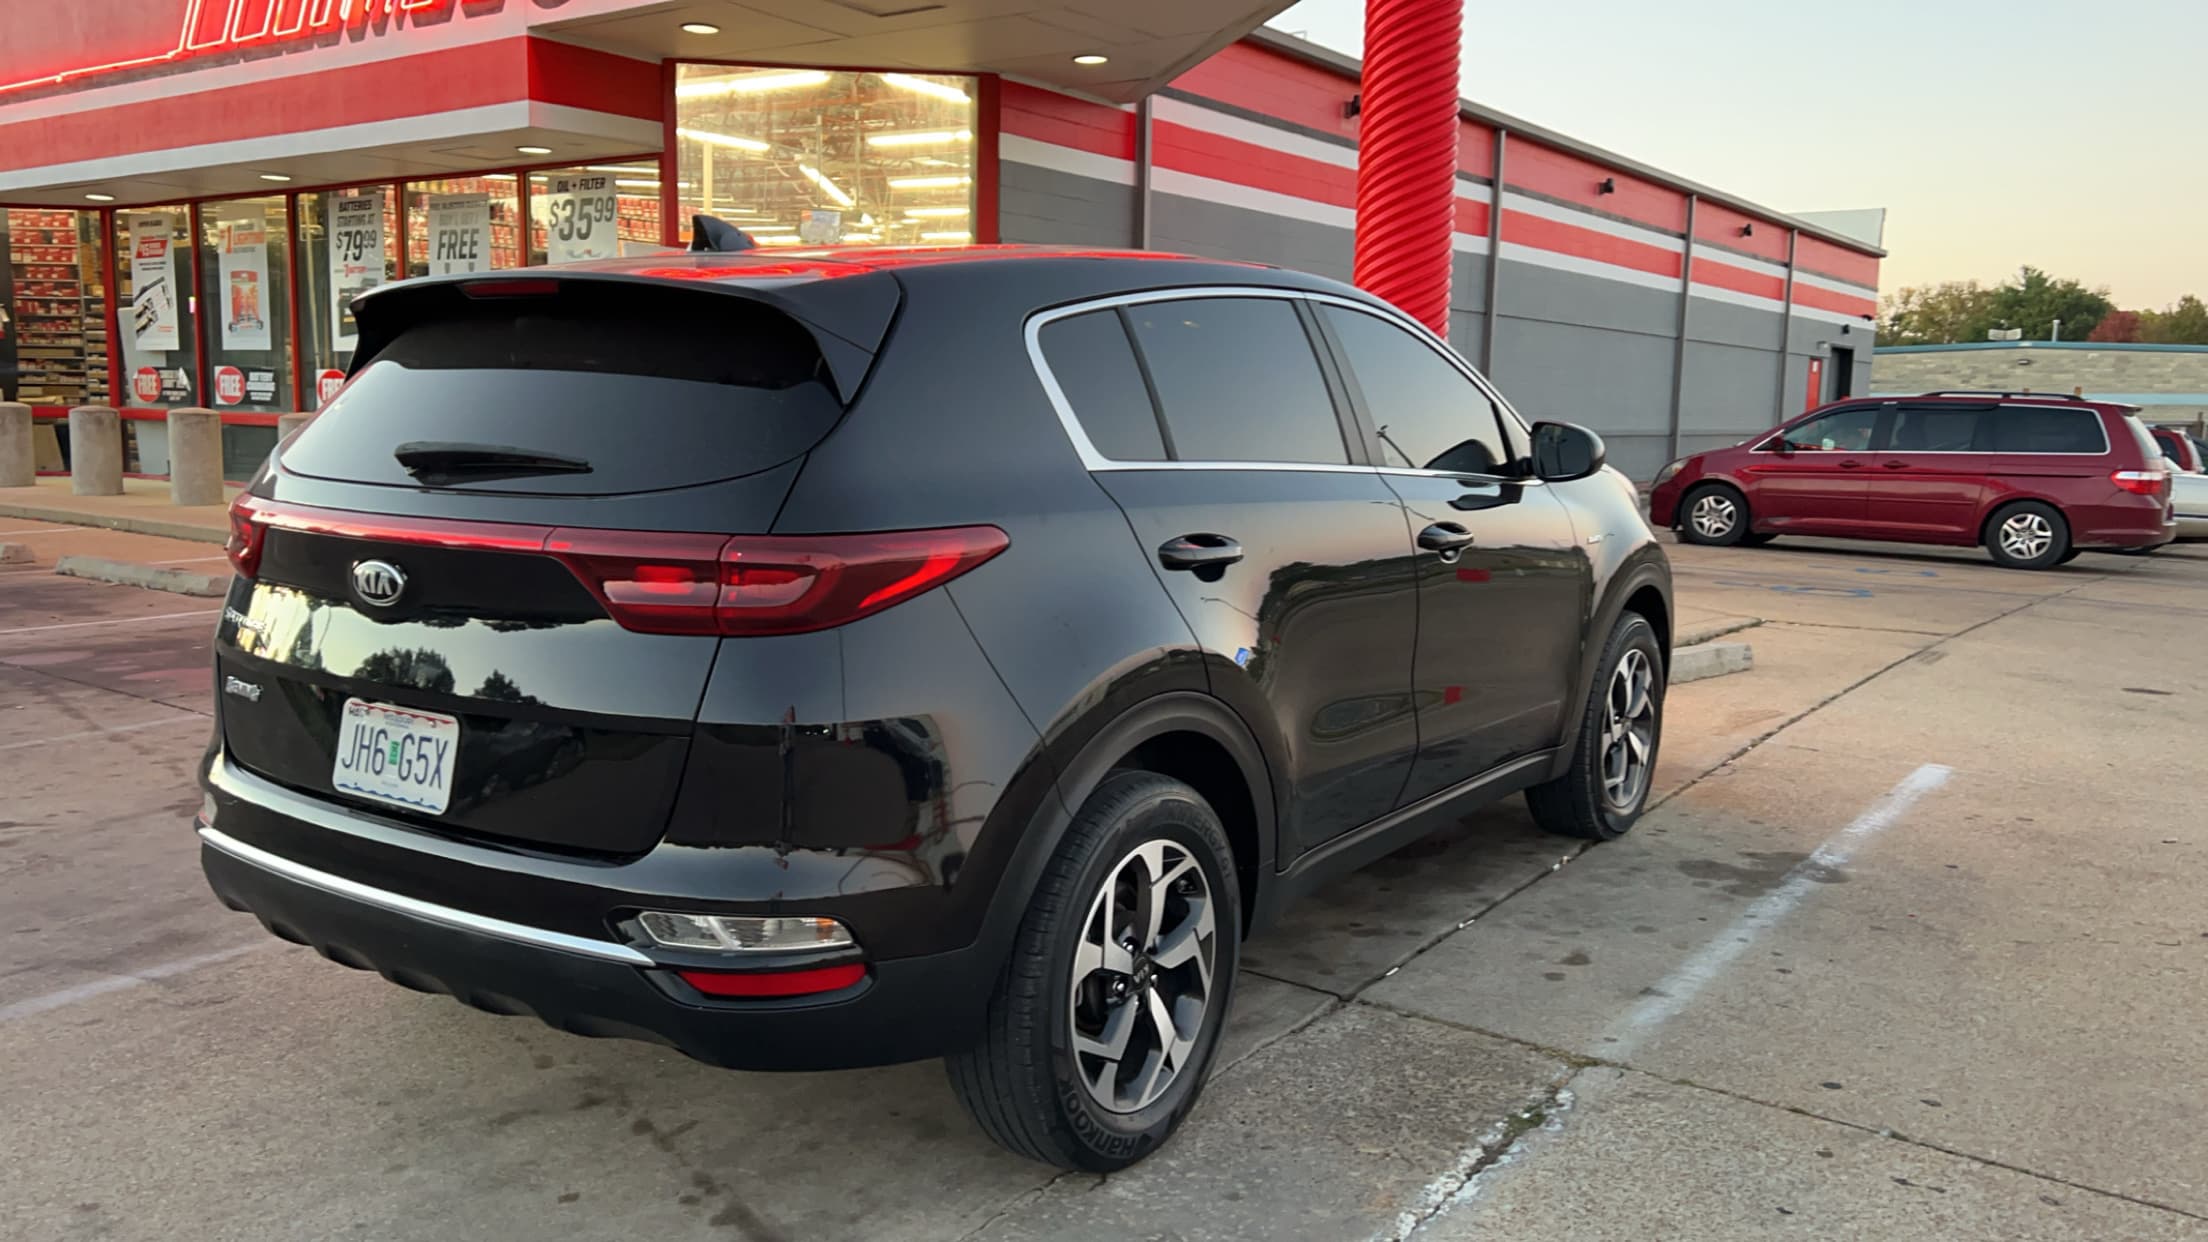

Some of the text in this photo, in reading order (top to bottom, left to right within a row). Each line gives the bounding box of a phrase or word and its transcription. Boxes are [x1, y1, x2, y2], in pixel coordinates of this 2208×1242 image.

[557, 180, 570, 193] OIL
[578, 177, 606, 191] FILTER
[338, 200, 373, 213] BATTERIES
[437, 229, 480, 260] FREE
[138, 374, 159, 395] FREE
[220, 374, 242, 396] FREE
[357, 570, 393, 595] KIA
[342, 724, 388, 775] JH6
[398, 733, 448, 790] G5X
